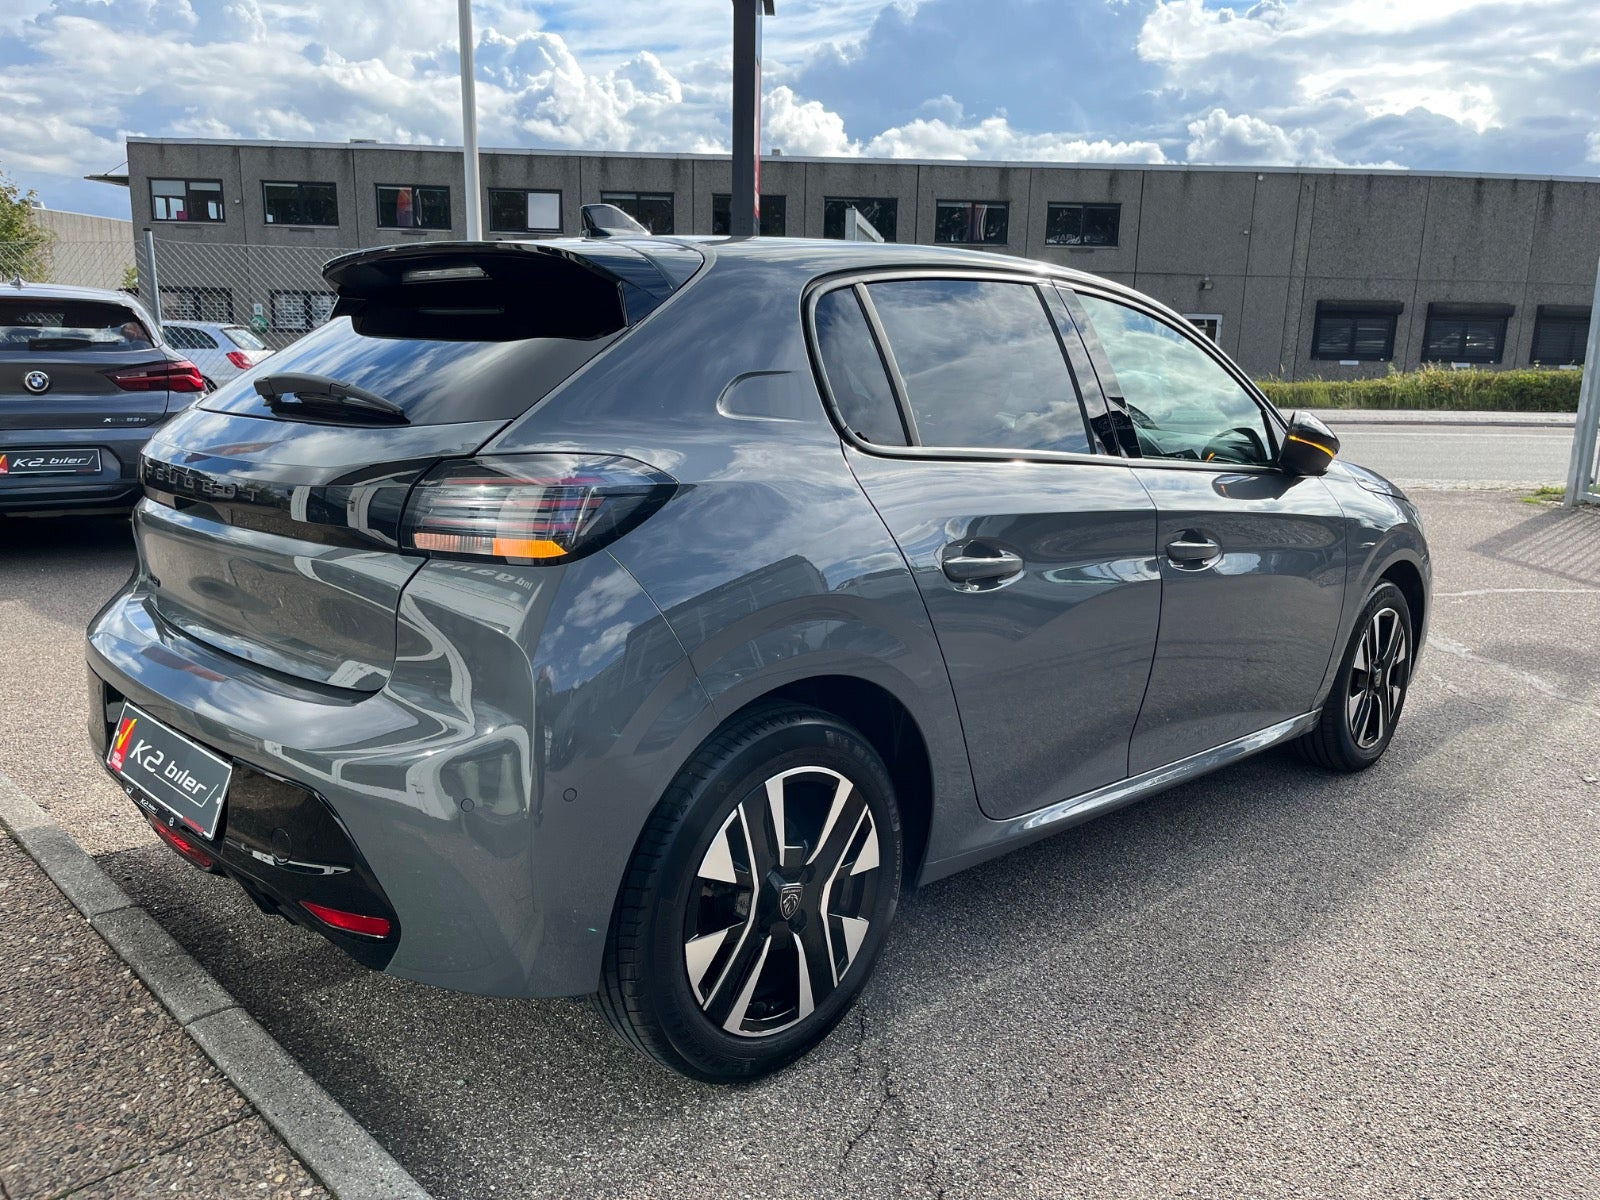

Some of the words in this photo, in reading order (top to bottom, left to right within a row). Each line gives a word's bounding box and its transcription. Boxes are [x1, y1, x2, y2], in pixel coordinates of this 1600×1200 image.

[12, 457, 45, 468] K2
[49, 456, 87, 464] biler
[130, 739, 165, 773] K2
[164, 760, 207, 795] biler
[139, 797, 149, 807] K2
